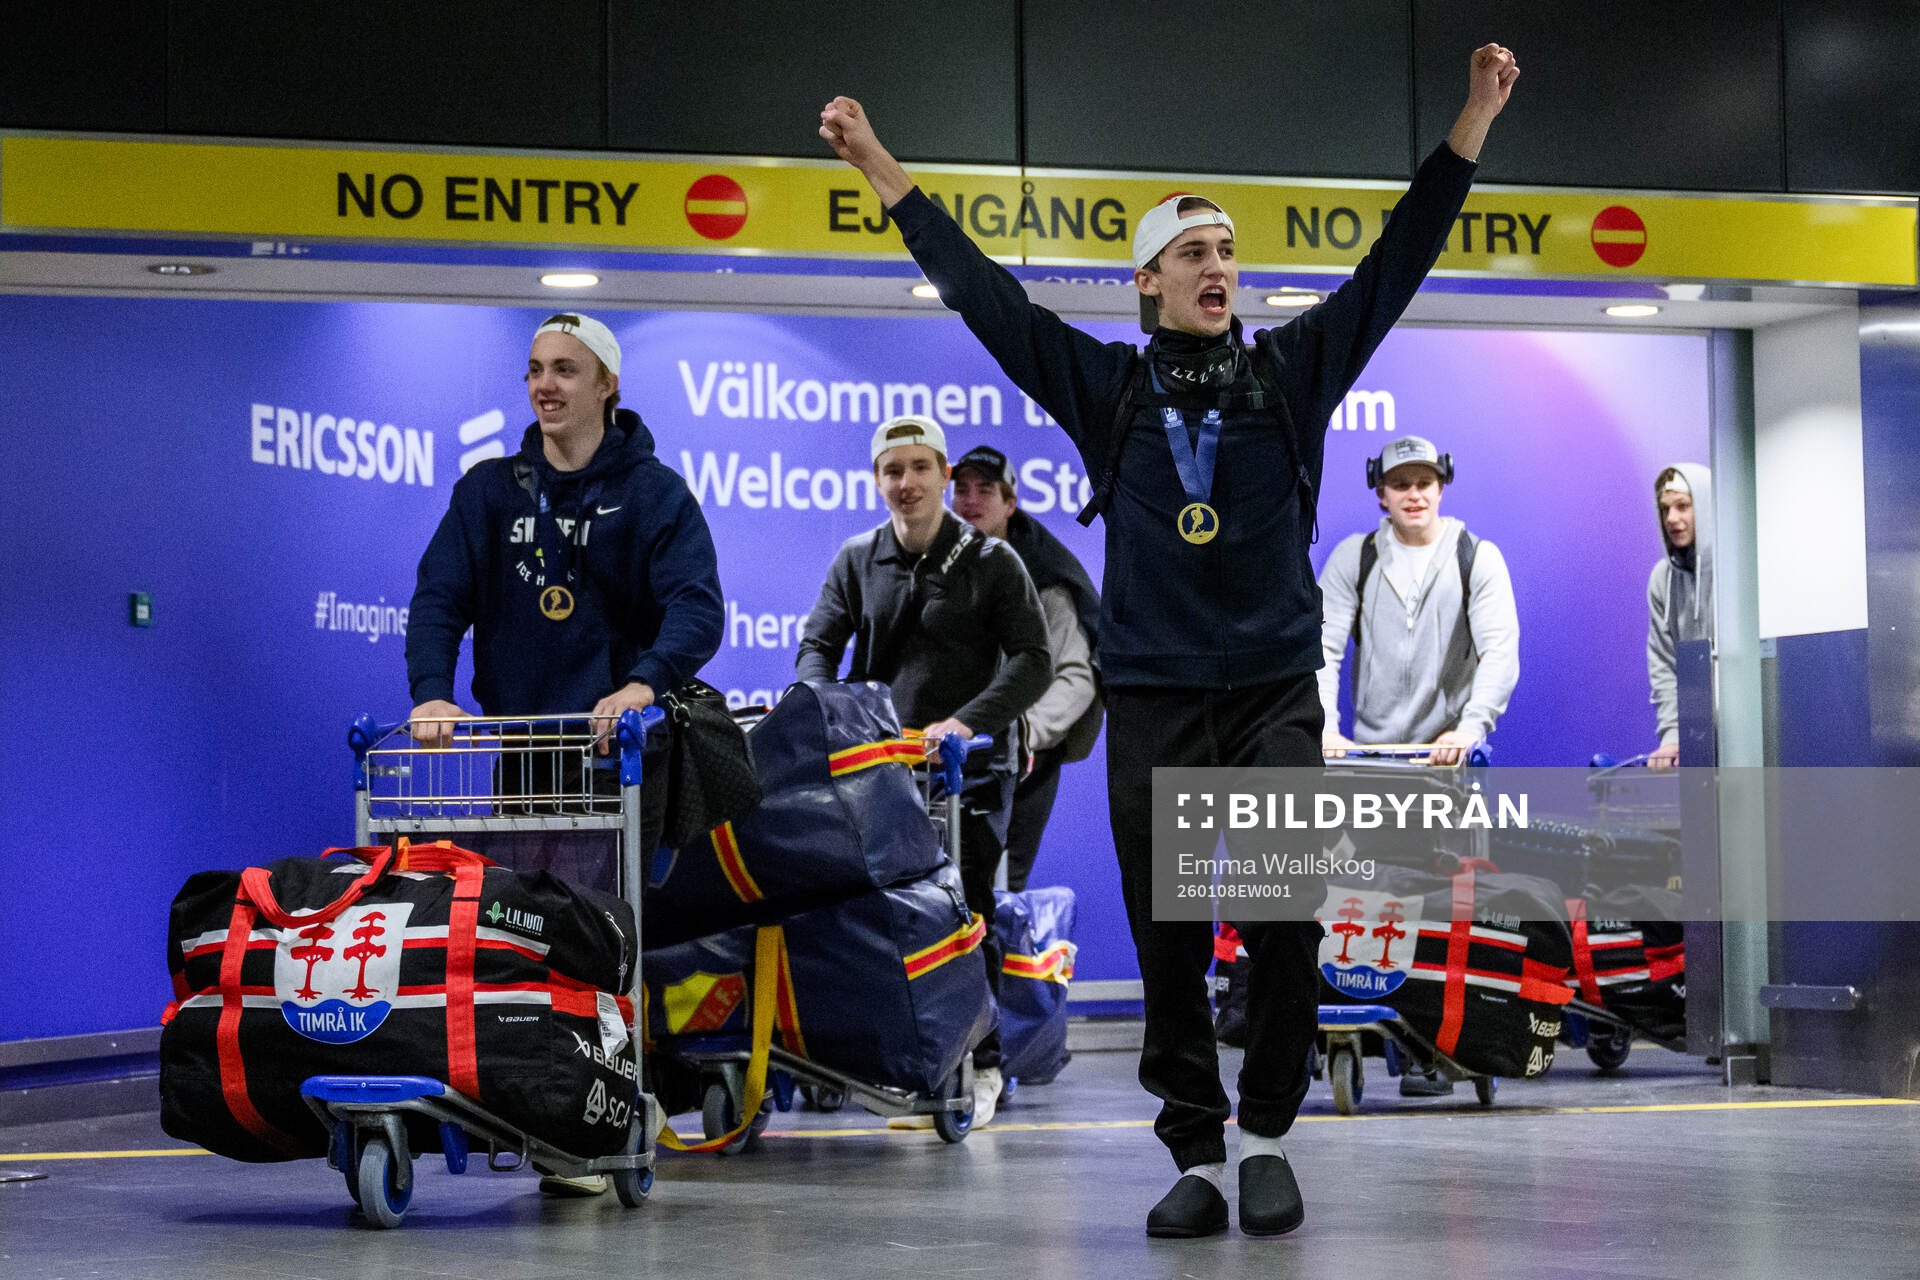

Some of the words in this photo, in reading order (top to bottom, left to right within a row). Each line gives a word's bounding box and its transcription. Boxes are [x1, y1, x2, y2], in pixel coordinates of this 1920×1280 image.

[337, 172, 424, 220] NO
[445, 176, 640, 226] ENTRY
[829, 189, 890, 235] EJ
[929, 181, 1127, 241] NGÅNG
[1286, 206, 1362, 250] NO
[678, 360, 1004, 427] Välkommen
[251, 403, 434, 487] ERICSSON
[506, 907, 544, 932] LILIUM
[1335, 971, 1372, 990] TIMRÅ
[1374, 976, 1388, 991] IK
[298, 1006, 347, 1032] TIMRÅ
[350, 1012, 367, 1032] IK
